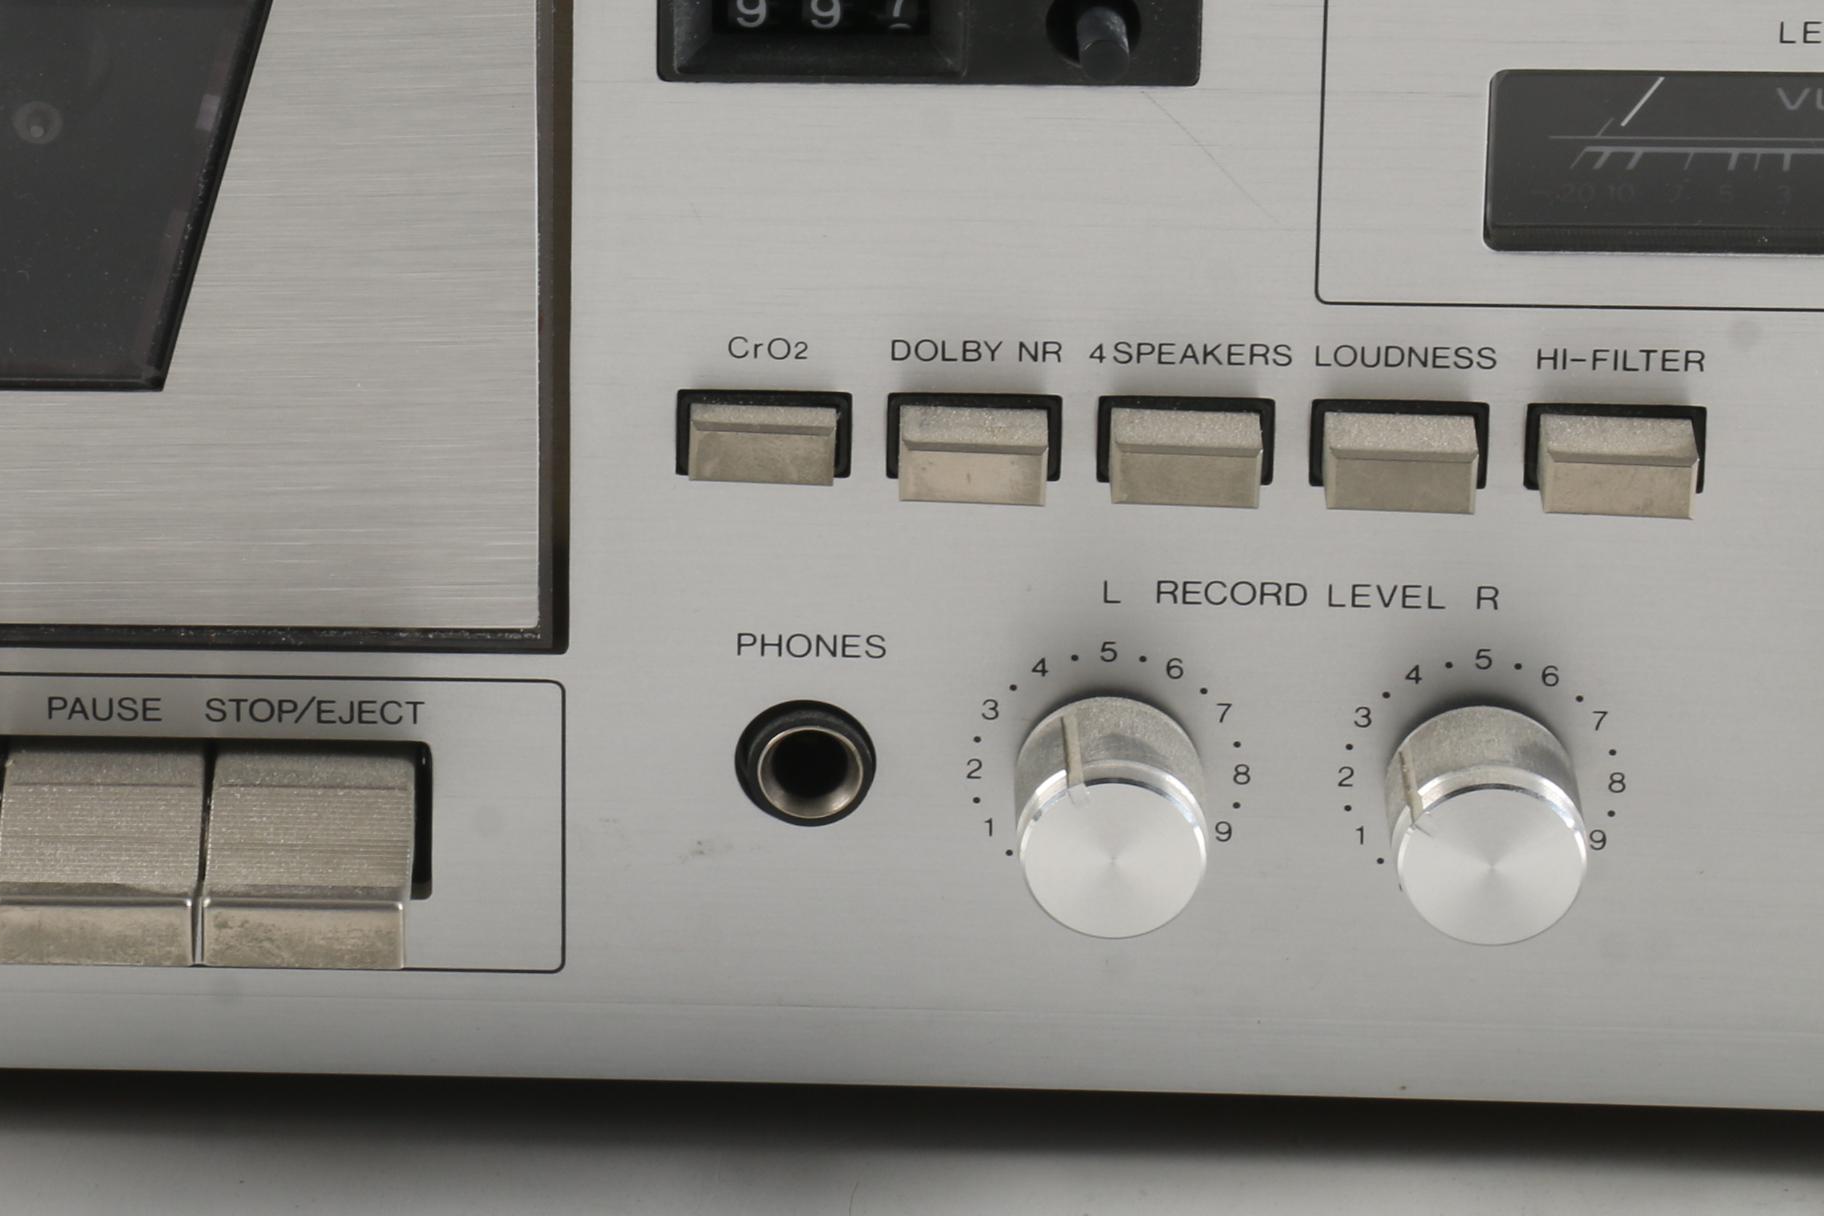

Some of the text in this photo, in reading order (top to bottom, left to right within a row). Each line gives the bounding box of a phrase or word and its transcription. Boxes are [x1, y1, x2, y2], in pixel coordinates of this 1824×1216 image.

[1779, 21, 1822, 44] LE
[891, 338, 1063, 363] DOLBY NR
[1315, 344, 1497, 370] LOUDNESS
[1536, 347, 1706, 372] HI-FILTER
[1103, 579, 1500, 611] L RECORD LEVEL R
[736, 632, 887, 659] PHONES
[1100, 641, 1118, 663] 5
[1031, 657, 1049, 678] 4
[1165, 657, 1184, 680] 6
[1475, 648, 1493, 671] 5
[1405, 664, 1423, 685] 4
[1540, 665, 1560, 687] 6
[47, 696, 163, 722] PAUSE
[204, 695, 425, 725] STOP/EJECT
[981, 698, 1000, 721] 3
[1216, 702, 1233, 724] 7
[1353, 706, 1373, 729] 3
[1592, 710, 1609, 732] 7
[966, 758, 983, 780] 2
[1232, 763, 1251, 786] 8
[1337, 766, 1355, 788] 2
[1607, 771, 1627, 794] 8
[1214, 820, 1233, 843] 9
[1589, 829, 1607, 851] 9
